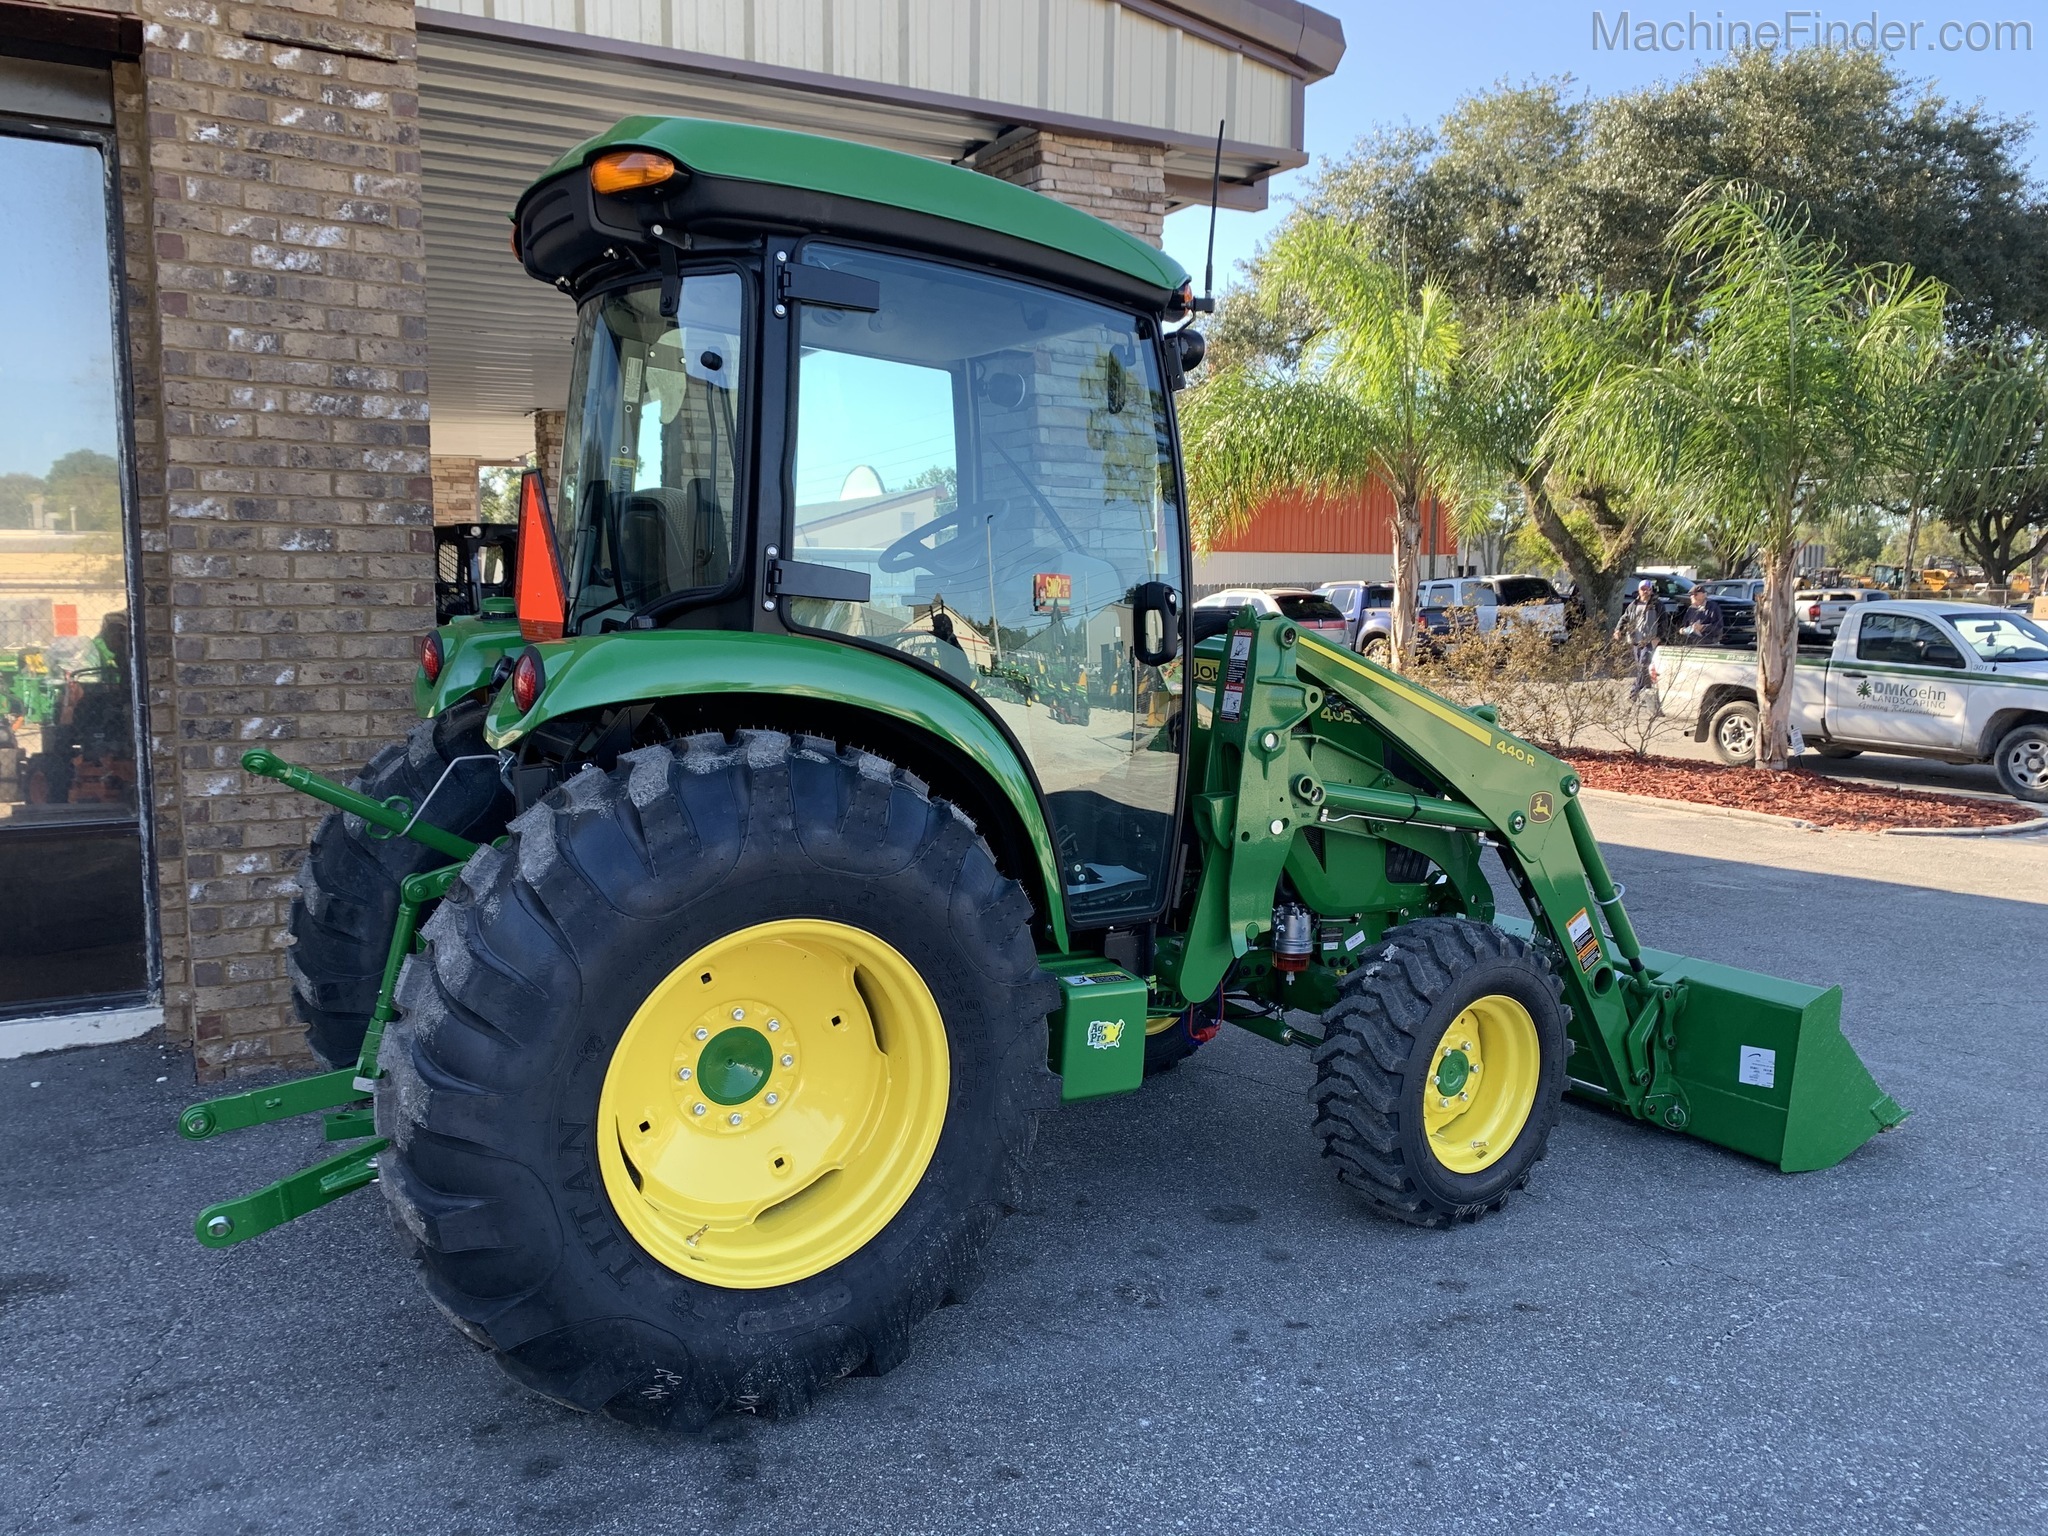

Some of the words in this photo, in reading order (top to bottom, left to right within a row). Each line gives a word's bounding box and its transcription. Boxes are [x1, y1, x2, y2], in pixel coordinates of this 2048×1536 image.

[1858, 700, 1889, 713] Growing
[1891, 704, 1942, 718] Relationships
[1872, 694, 1946, 709] LANDSCAPING
[1496, 740, 1525, 761] 440
[1526, 753, 1535, 767] R
[1091, 1033, 1107, 1043] Pro
[558, 1117, 643, 1288] TITAN
